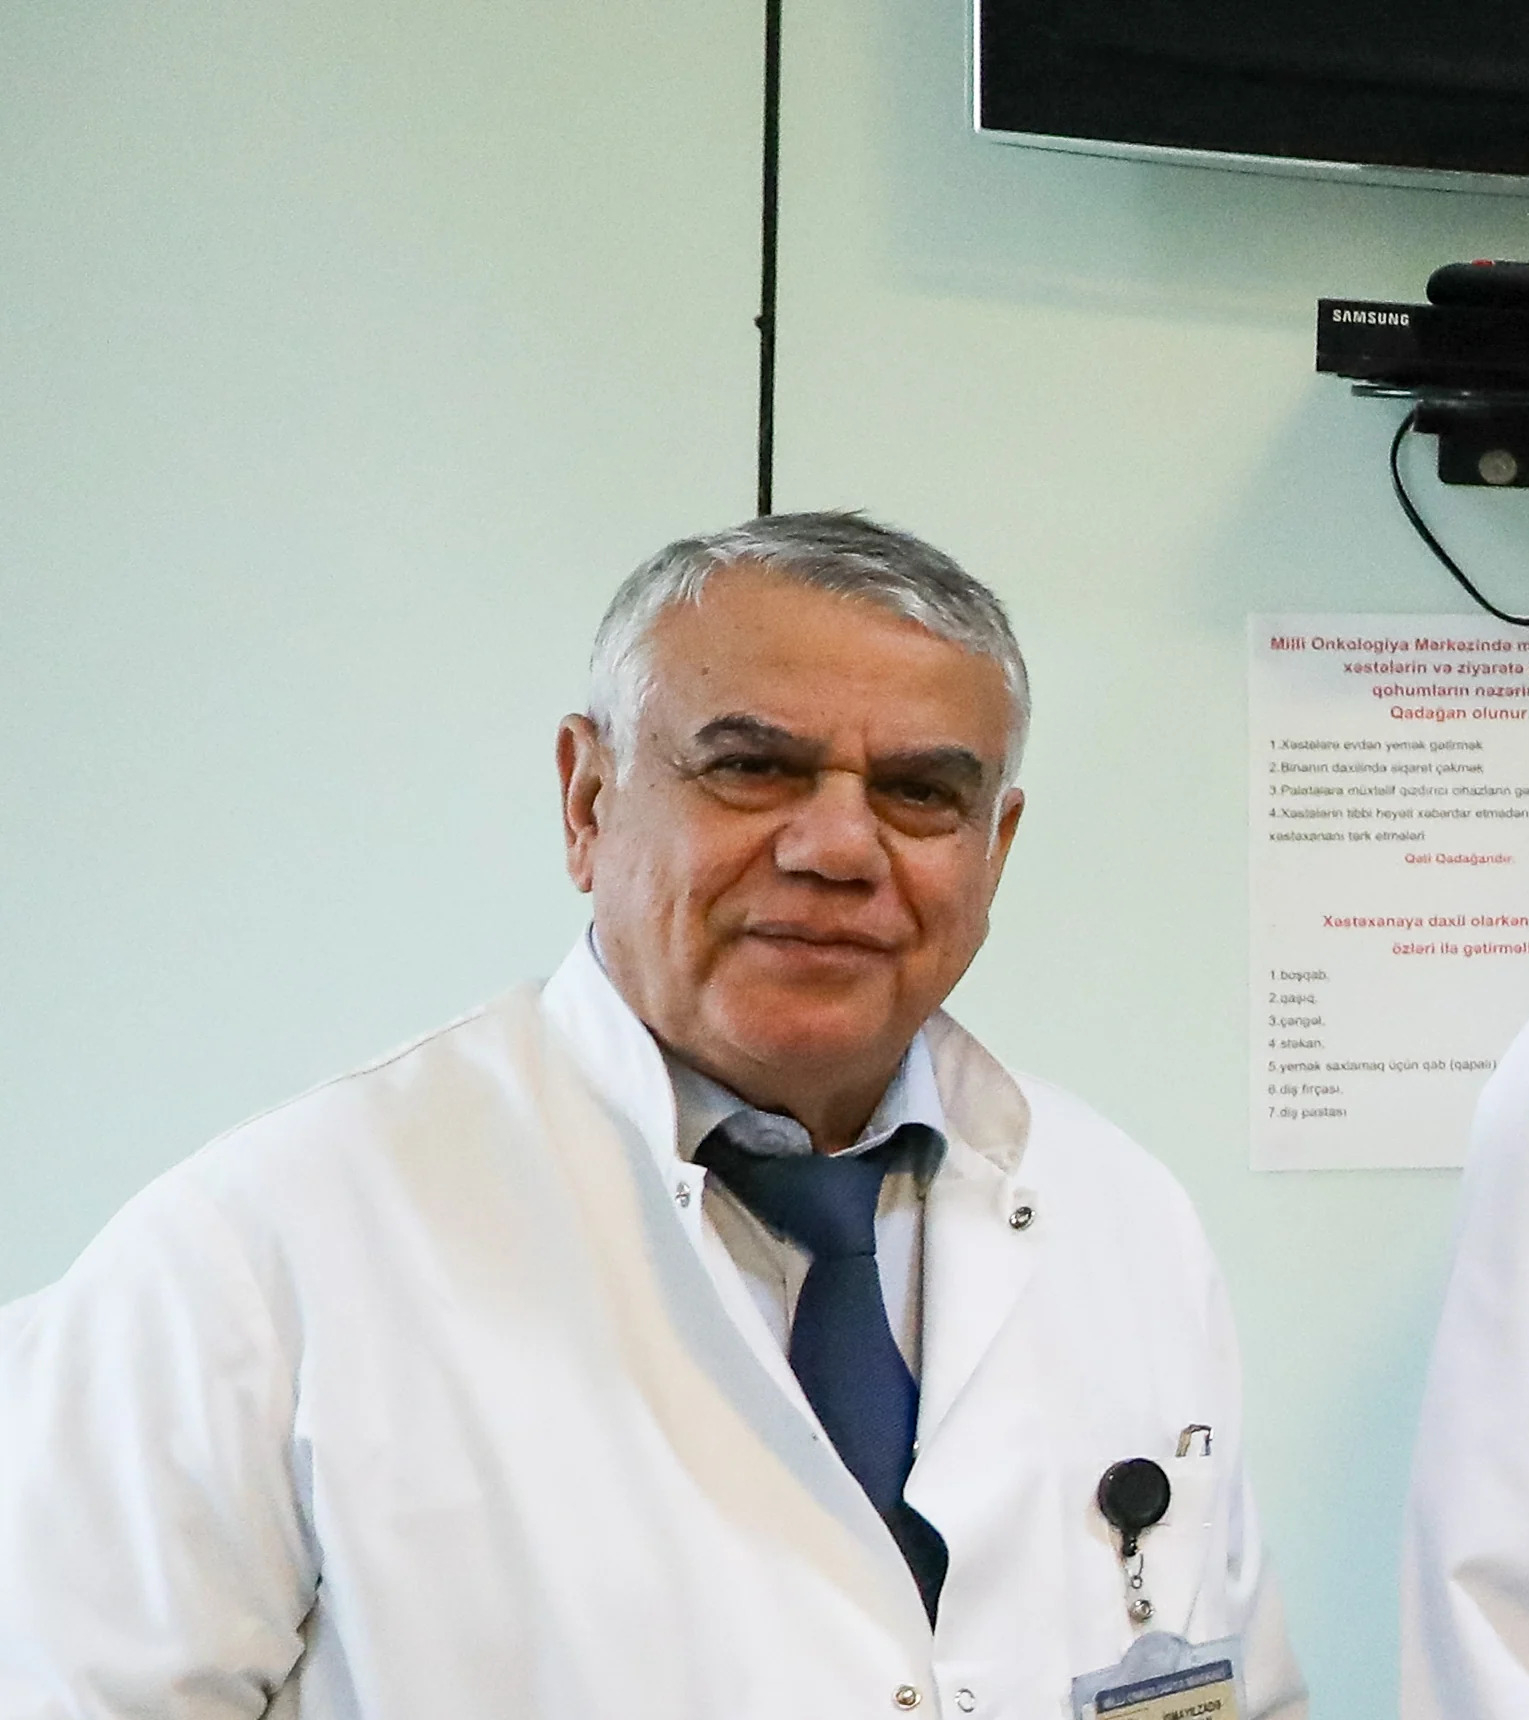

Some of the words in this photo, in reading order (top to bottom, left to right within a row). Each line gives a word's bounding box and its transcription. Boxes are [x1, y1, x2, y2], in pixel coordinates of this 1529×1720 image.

[1333, 309, 1409, 326] SAMSUNG
[1271, 637, 1306, 650] Milli
[1312, 637, 1409, 653] Onkologiya
[1433, 664, 1451, 673] və
[1391, 705, 1466, 721] Qadağan
